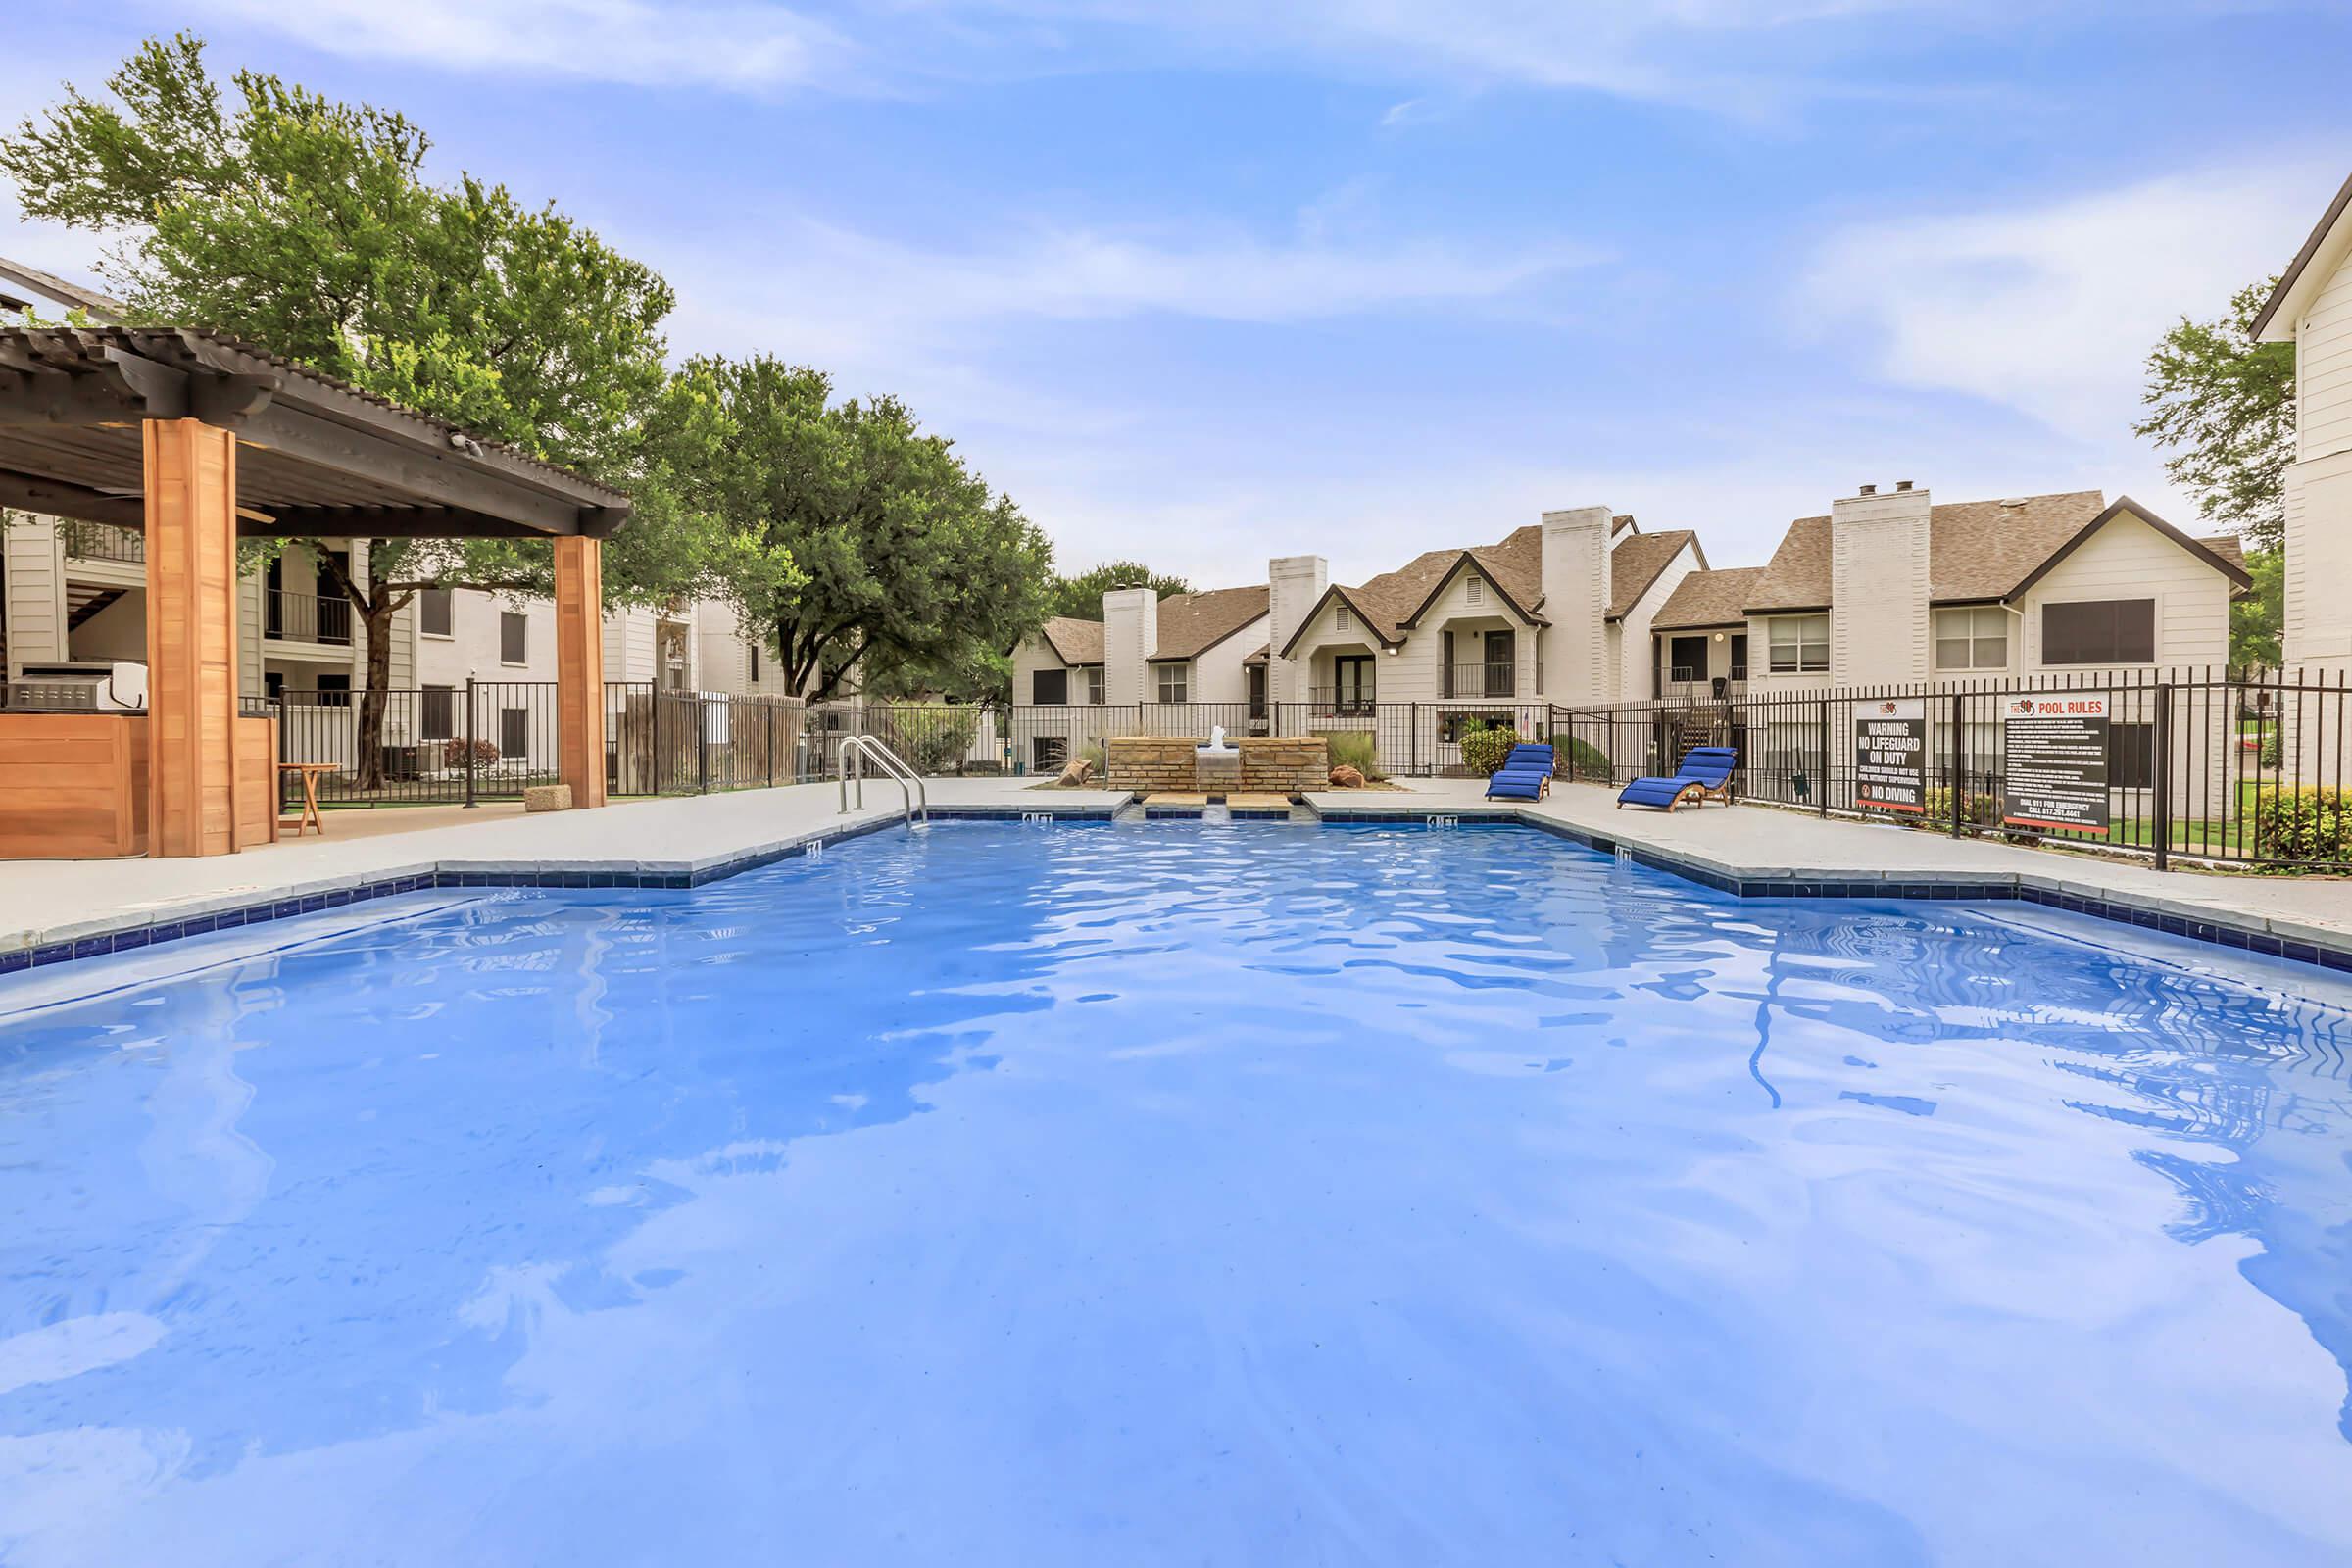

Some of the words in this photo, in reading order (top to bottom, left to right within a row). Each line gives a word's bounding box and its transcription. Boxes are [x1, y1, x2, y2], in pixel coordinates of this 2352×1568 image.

[2038, 702, 2065, 714] POOL
[2068, 701, 2102, 713] RULES
[1868, 722, 1909, 736] WARNING
[1858, 736, 1870, 750] NO
[1872, 737, 1920, 752] LIFEGUARD
[1869, 751, 1882, 764] ON
[1884, 752, 1907, 765] DUTY
[1871, 785, 1884, 799] NO
[1886, 787, 1916, 803] DIVING
[2055, 801, 2090, 811] EMERGENCY
